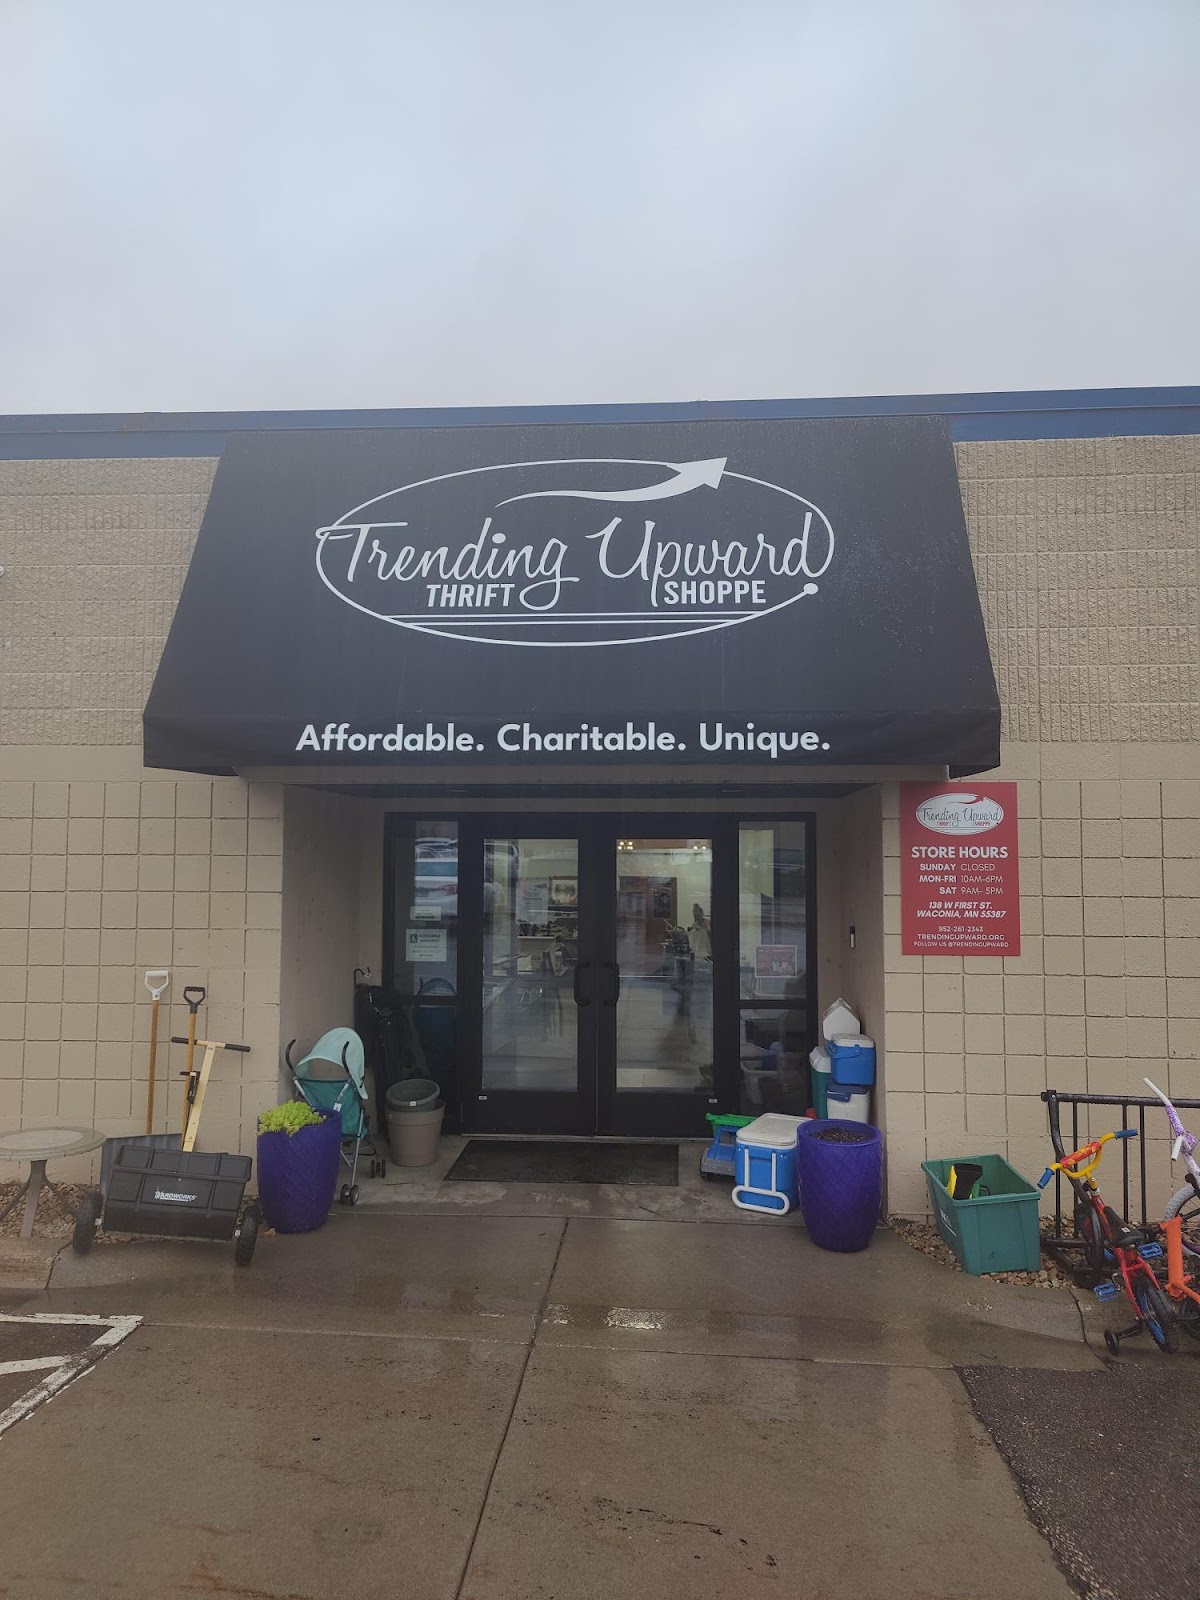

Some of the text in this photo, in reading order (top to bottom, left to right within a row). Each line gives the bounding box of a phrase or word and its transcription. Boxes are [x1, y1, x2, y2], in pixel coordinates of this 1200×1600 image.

[317, 511, 818, 611] Trending Upward
[426, 583, 515, 608] THRIFT
[663, 579, 767, 605] SHOPPE
[295, 722, 831, 759] Affordable. Charitable. Unique.
[919, 807, 1001, 828] Trending Upward
[911, 846, 1009, 859] STORE HOURS
[919, 863, 996, 871] SUNDAY CLOSED
[919, 875, 1004, 883] MON-FRI 10AM-6PM
[939, 887, 957, 895] SAT
[985, 887, 1004, 895] 5PM
[928, 901, 943, 909] 138
[944, 901, 953, 909] W
[954, 901, 978, 909] FIRST
[916, 910, 1007, 919] WACONIA, MN 55387
[917, 933, 1005, 941] TRENDINGUPWARD.ORG
